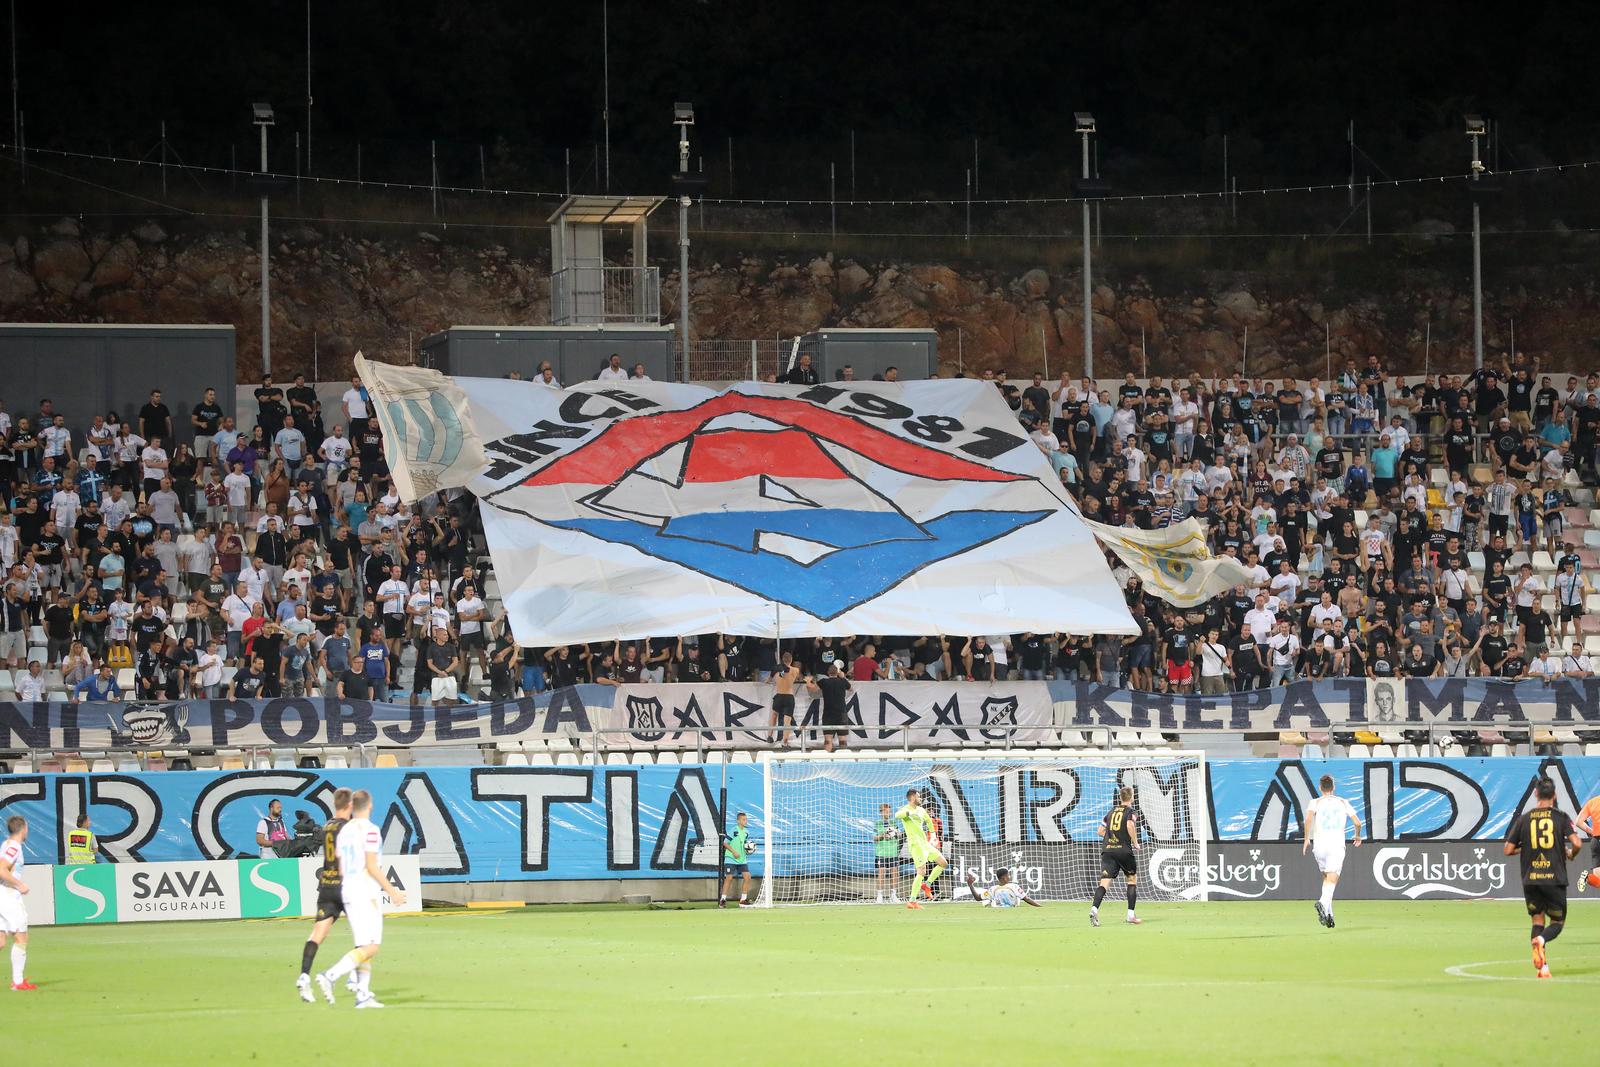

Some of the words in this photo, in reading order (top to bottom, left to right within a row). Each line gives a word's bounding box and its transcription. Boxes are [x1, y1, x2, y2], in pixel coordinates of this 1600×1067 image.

[210, 684, 592, 746] POBJEDA
[1110, 811, 1123, 831] 19
[1530, 818, 1554, 849] 13
[324, 831, 336, 862] 6
[1149, 849, 1282, 891] Carsberg
[1373, 847, 1506, 889] Carlsberg
[132, 870, 224, 899] SAVA
[133, 900, 226, 912] OSIGURANJE
